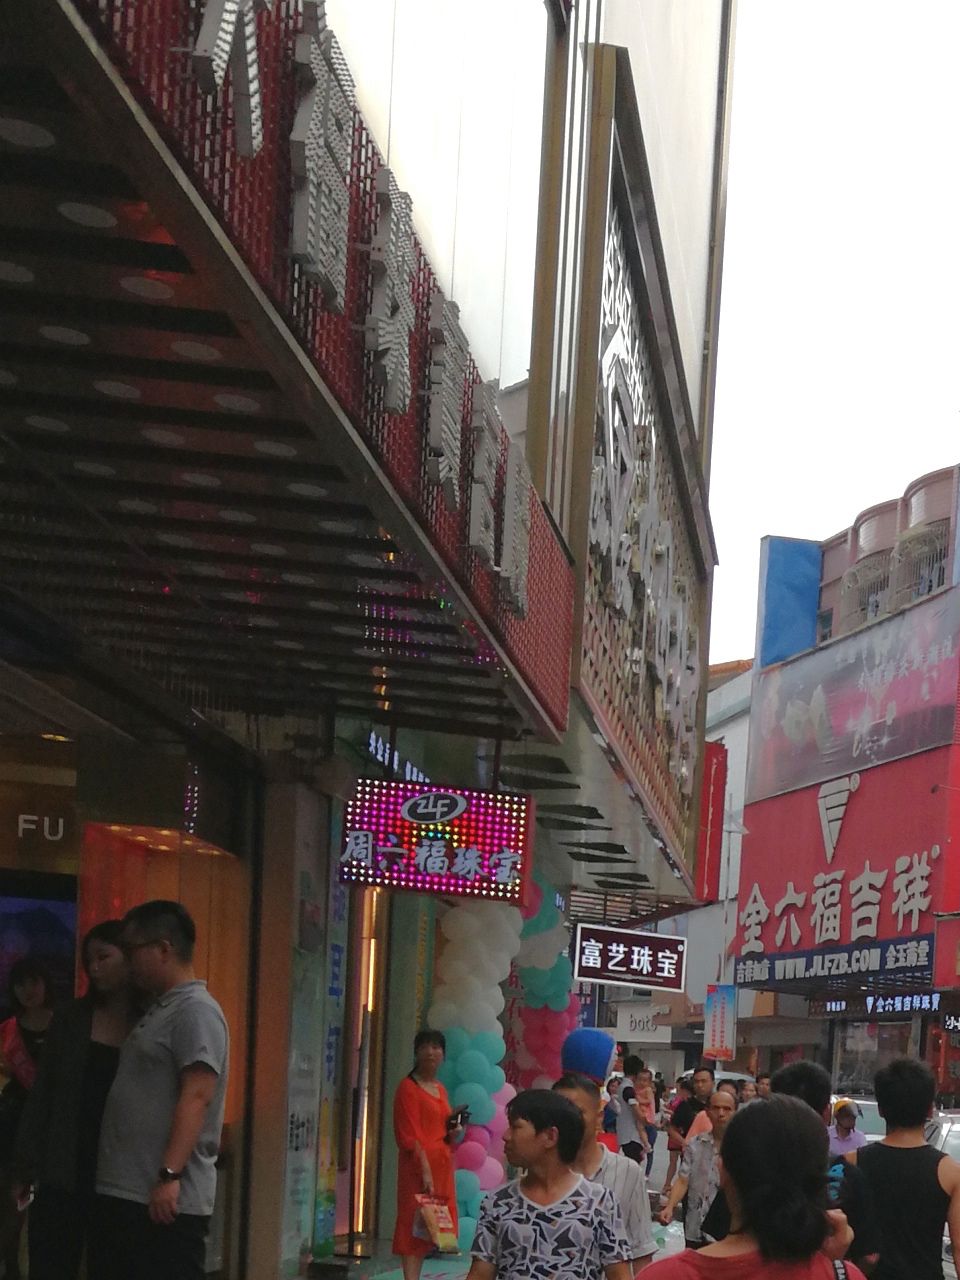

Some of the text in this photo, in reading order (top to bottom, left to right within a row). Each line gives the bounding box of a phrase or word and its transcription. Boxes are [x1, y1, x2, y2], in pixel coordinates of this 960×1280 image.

[18, 814, 64, 840] FU
[340, 831, 522, 883] 周六福珠宝
[739, 851, 932, 956] 金六福吉祥
[581, 938, 679, 978] 富艺珠宝
